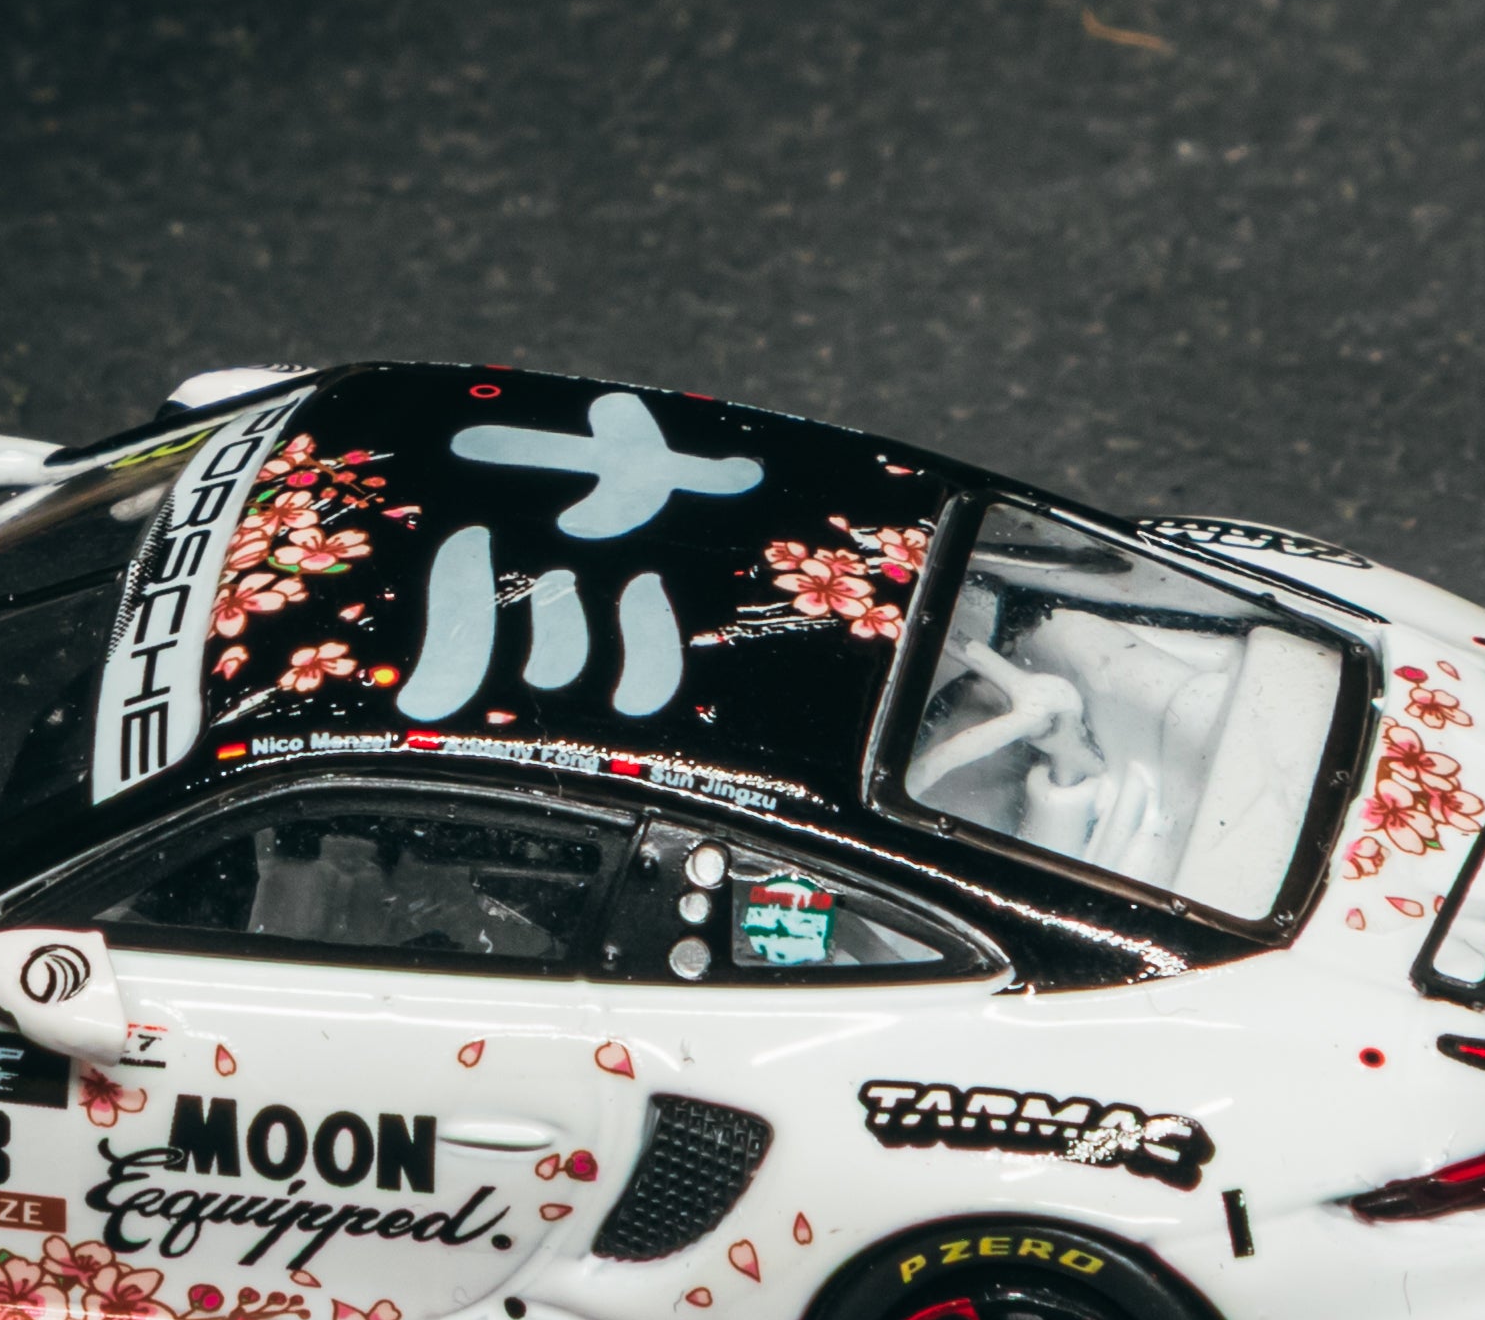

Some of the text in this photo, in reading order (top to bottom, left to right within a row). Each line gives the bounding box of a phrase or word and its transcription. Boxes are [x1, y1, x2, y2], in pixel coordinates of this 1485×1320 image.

[120, 397, 299, 781] PORSCHE
[251, 736, 304, 756] Nico
[649, 764, 778, 811] Sun Jingzu
[164, 1093, 437, 1194] MOON
[867, 1086, 1193, 1163] TARMAC
